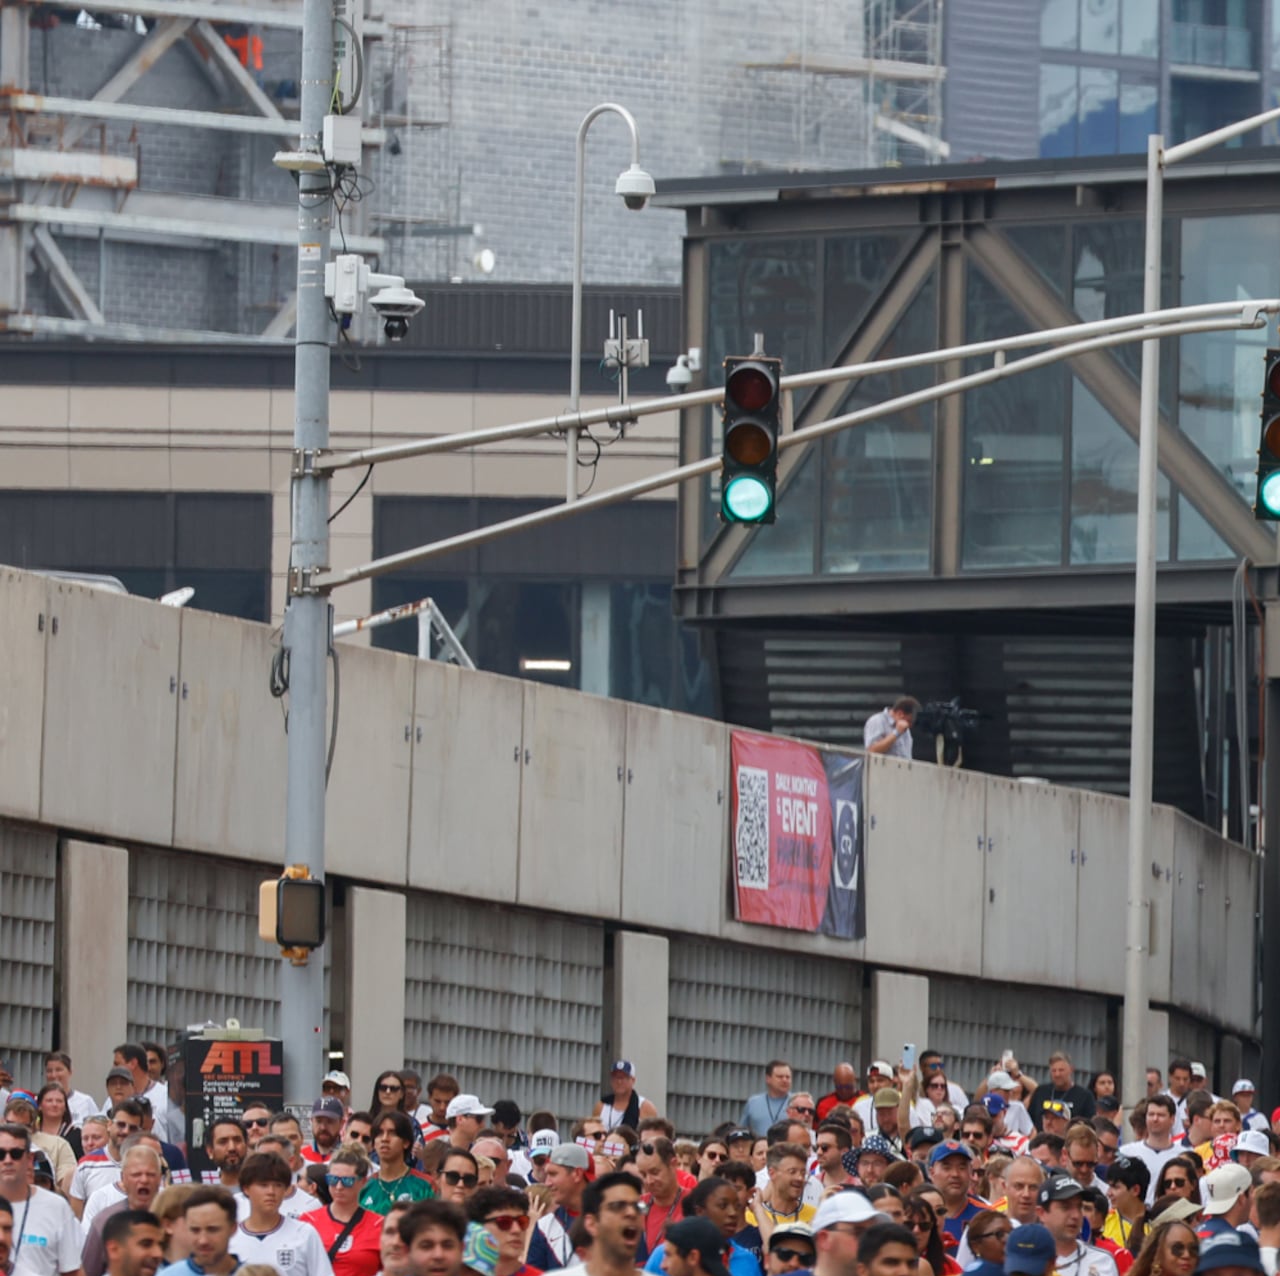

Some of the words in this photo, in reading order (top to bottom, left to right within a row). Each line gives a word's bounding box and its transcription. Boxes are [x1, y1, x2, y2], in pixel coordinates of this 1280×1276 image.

[775, 772, 791, 794] DAILY,
[791, 775, 818, 796] MONTHLY
[782, 799, 818, 837] EVENT
[200, 1042, 281, 1074] ATL
